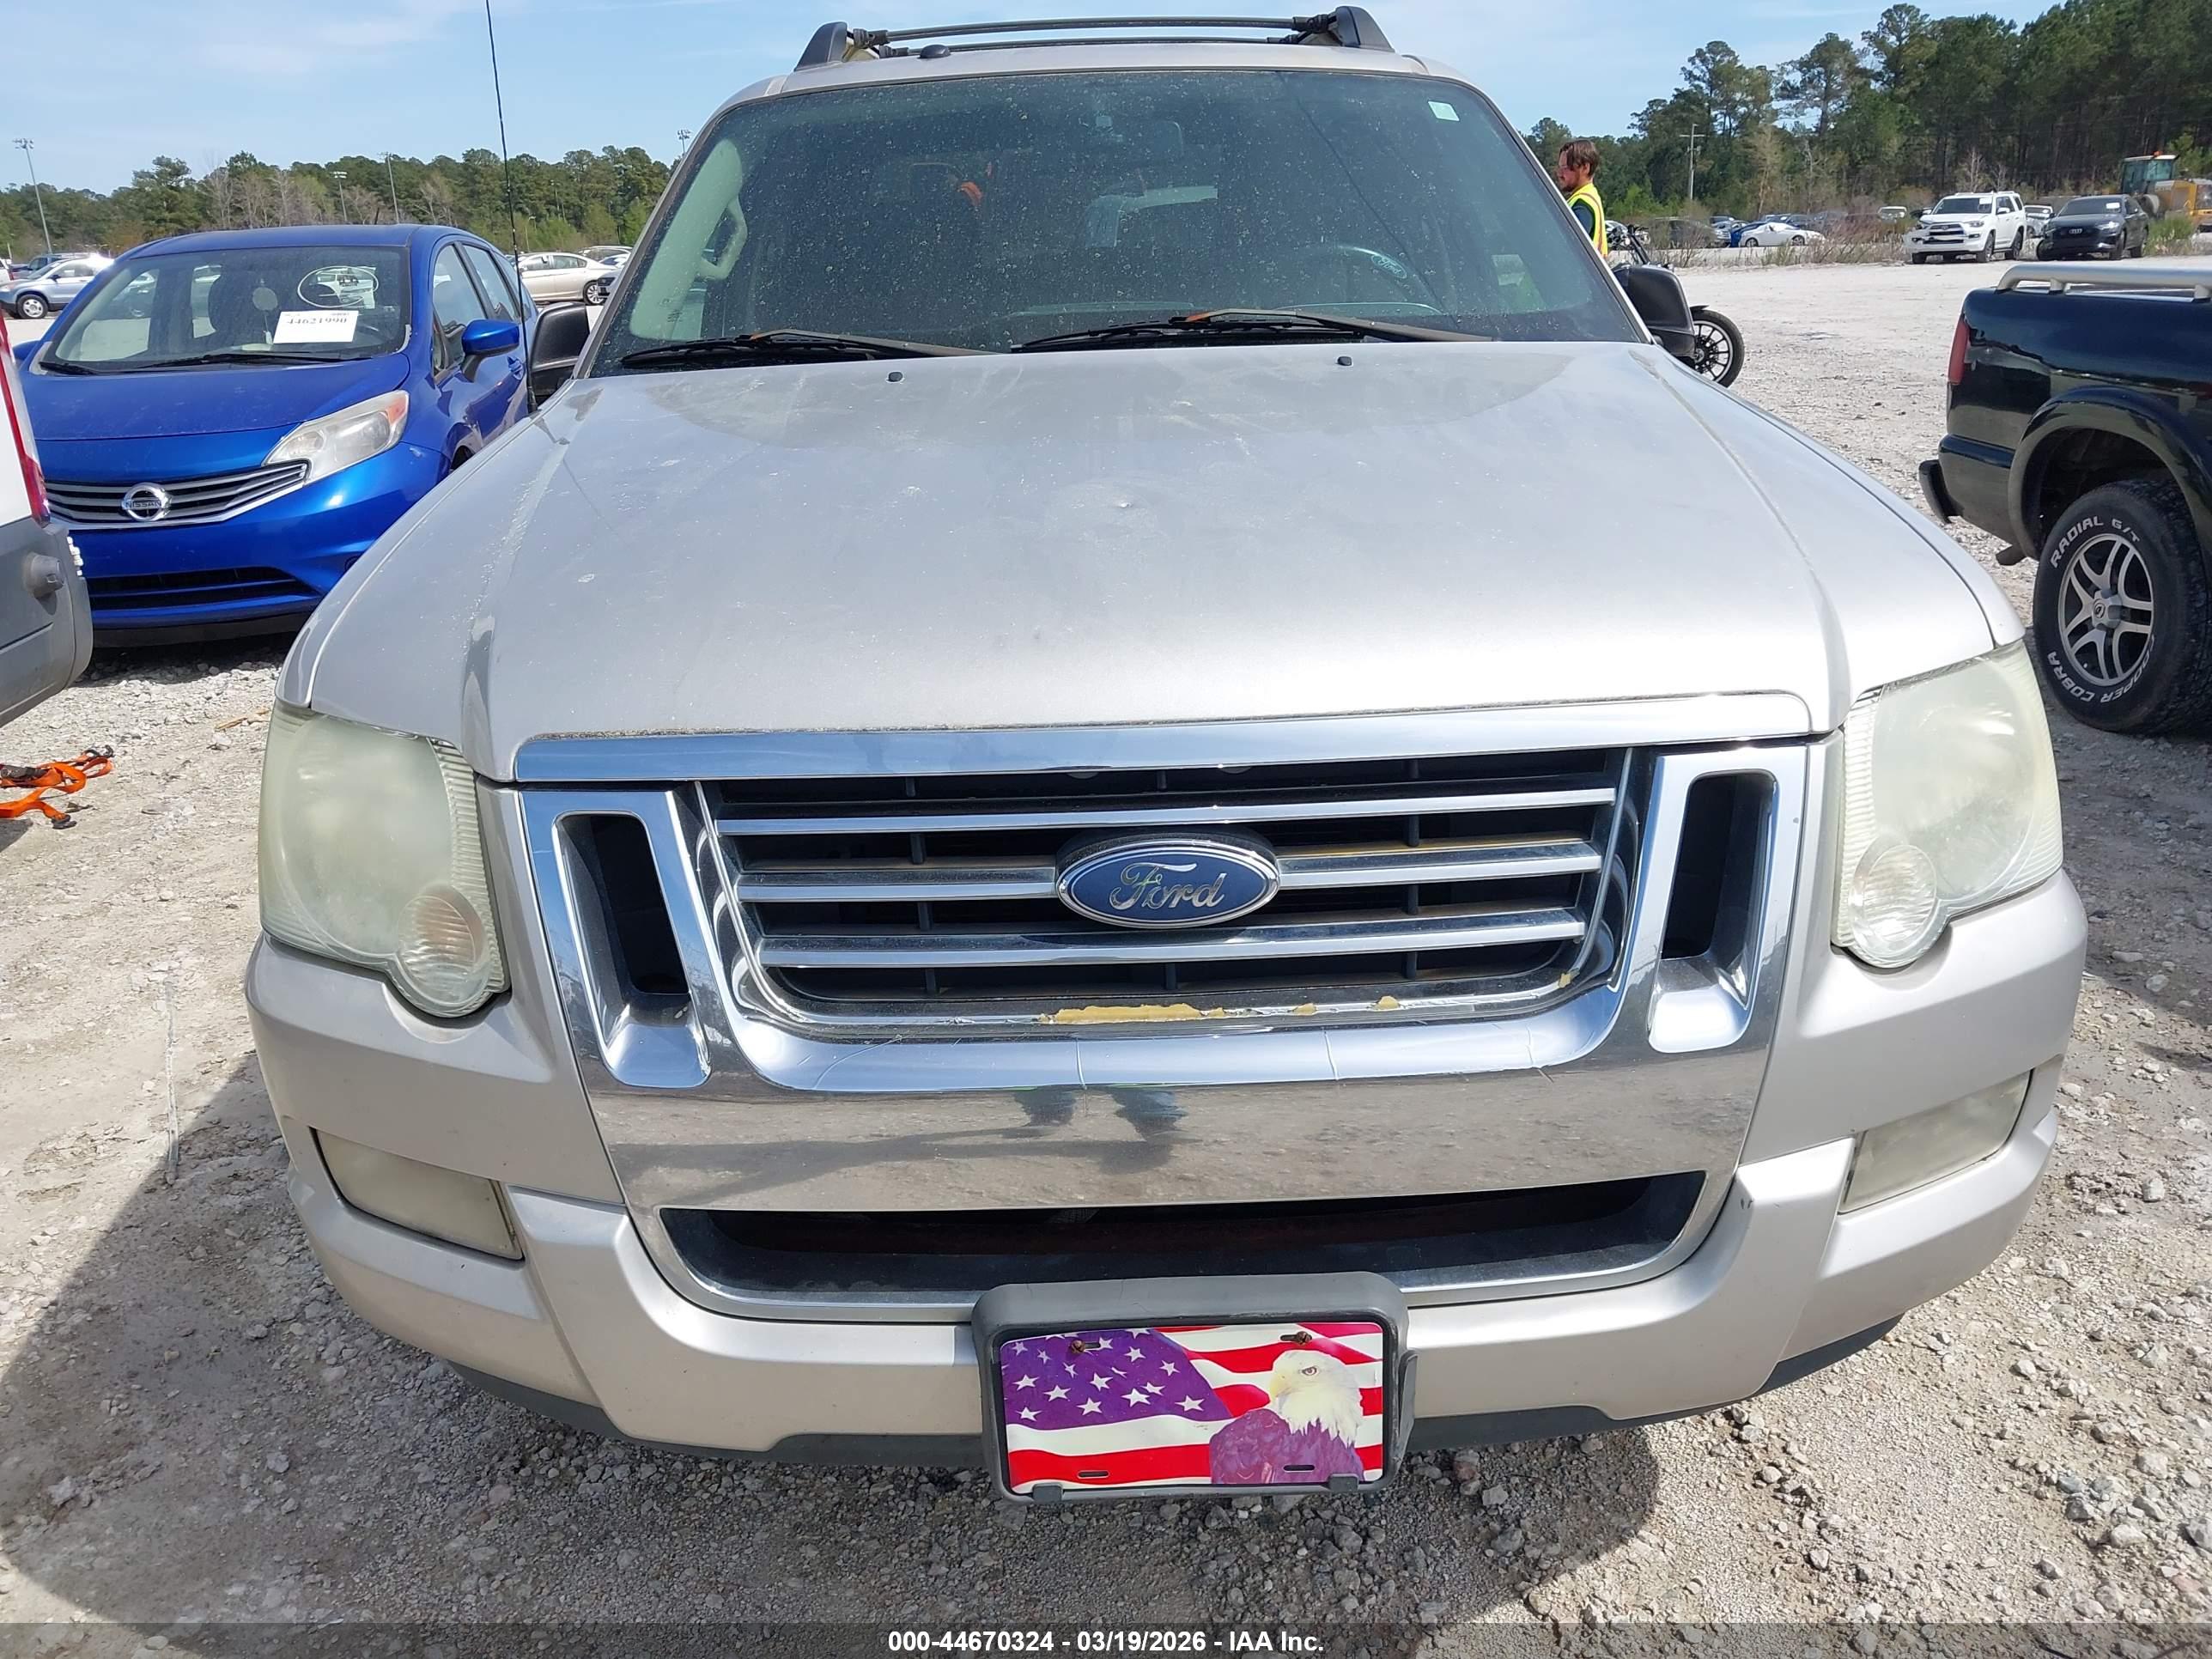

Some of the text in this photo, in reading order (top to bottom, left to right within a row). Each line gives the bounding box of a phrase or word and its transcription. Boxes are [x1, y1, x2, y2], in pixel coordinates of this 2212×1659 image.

[125, 500, 162, 508] NISSAN
[2050, 515, 2140, 568] RADIAL G/T
[2047, 634, 2154, 703] COOPER COBRA
[1109, 862, 1227, 910] Ford
